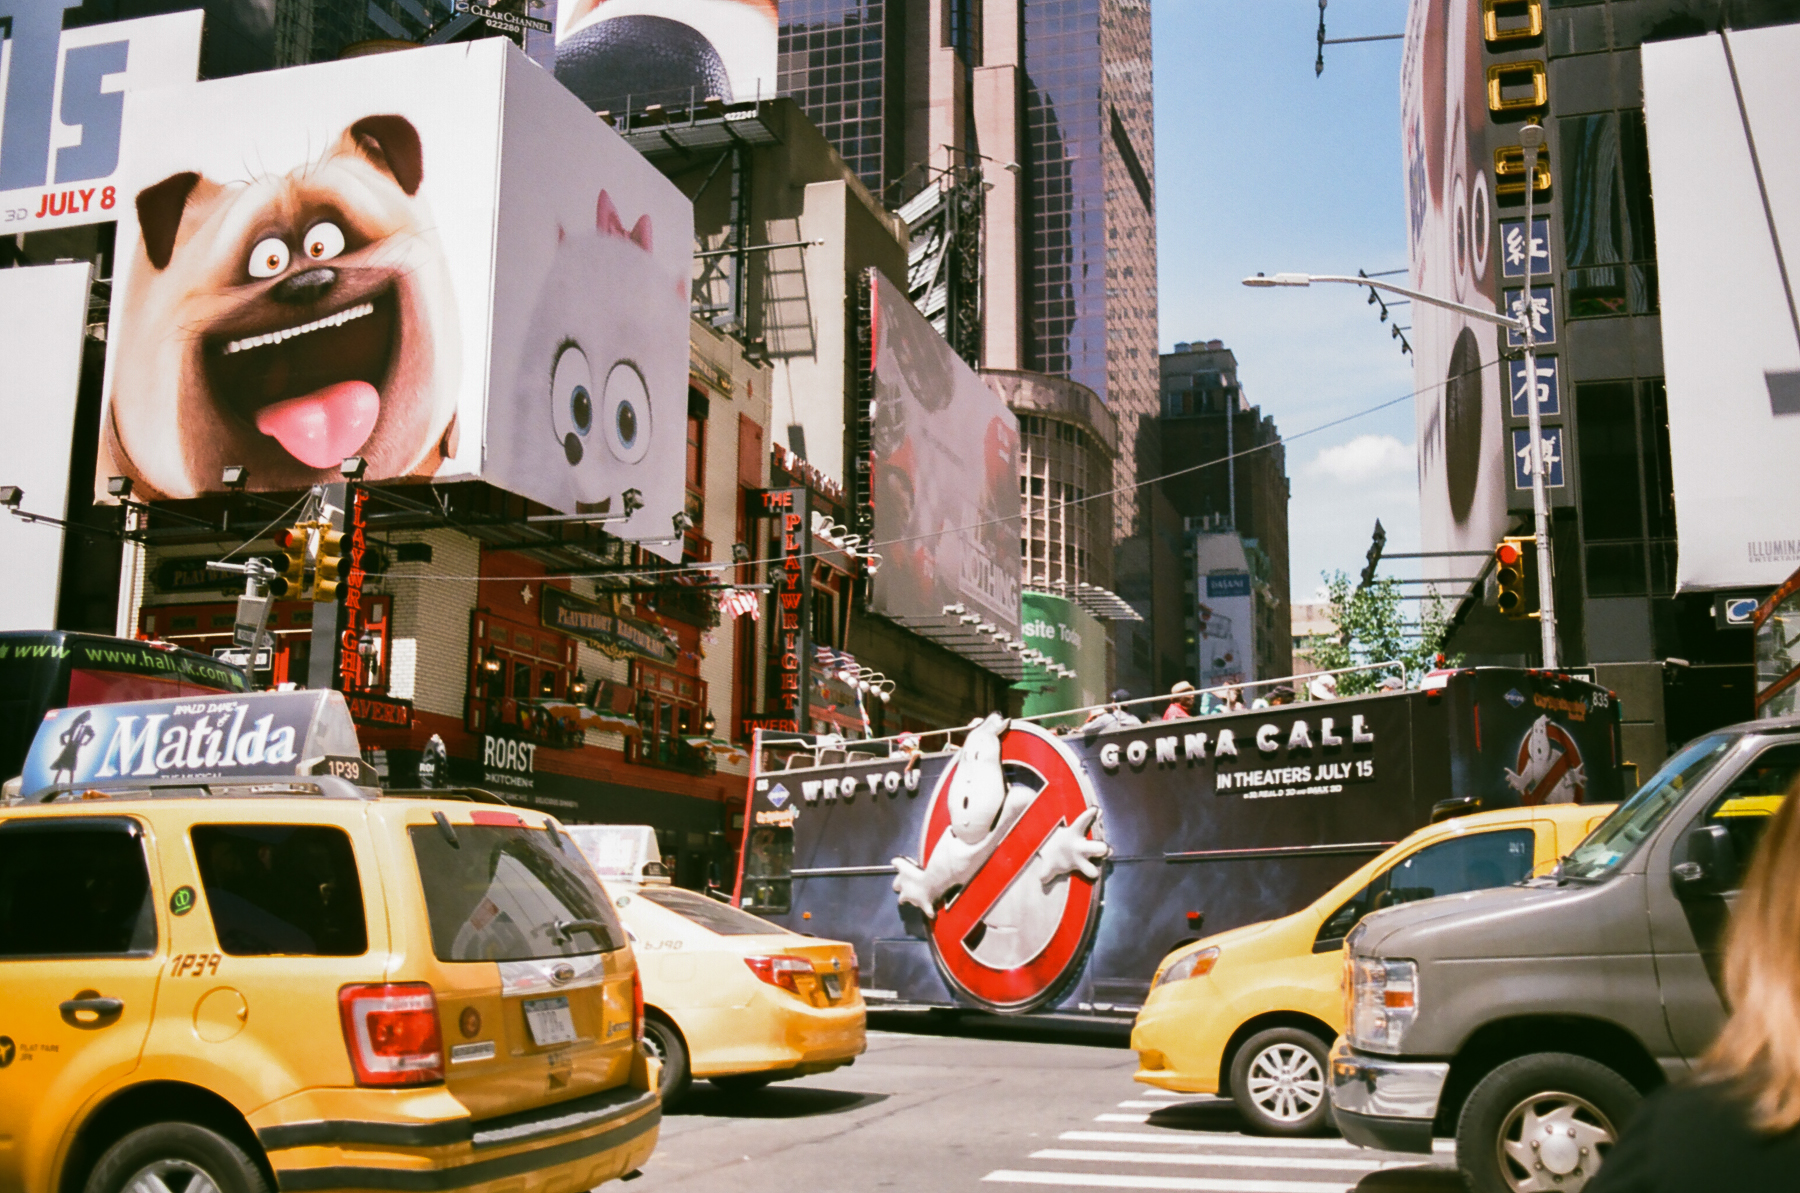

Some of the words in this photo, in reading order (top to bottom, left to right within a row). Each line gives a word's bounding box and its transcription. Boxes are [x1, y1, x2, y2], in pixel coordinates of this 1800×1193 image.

[5, 208, 28, 222] 3D
[35, 188, 96, 219] JULY
[100, 186, 116, 210] 8
[761, 492, 792, 507] THE
[340, 488, 369, 692] PLAYWRIGHT
[780, 514, 802, 711] PLAYWRIGHT
[1021, 619, 1056, 640] site
[345, 696, 408, 726] AVERN
[1592, 691, 1609, 708] 835
[742, 718, 799, 734] TAVERN
[94, 703, 298, 777] Matilda
[484, 735, 537, 773] ROAST
[802, 776, 858, 801] WHO
[866, 769, 922, 796] YOU
[1100, 729, 1238, 769] GONNA
[1256, 715, 1374, 751] CALL
[328, 760, 360, 780] 1P39
[490, 773, 528, 788] KITCHEN
[1216, 773, 1232, 789] IN
[1236, 765, 1311, 786] THEATERS
[1314, 761, 1352, 782] JULY
[1356, 760, 1373, 778] 15
[170, 954, 223, 977] 1P39
